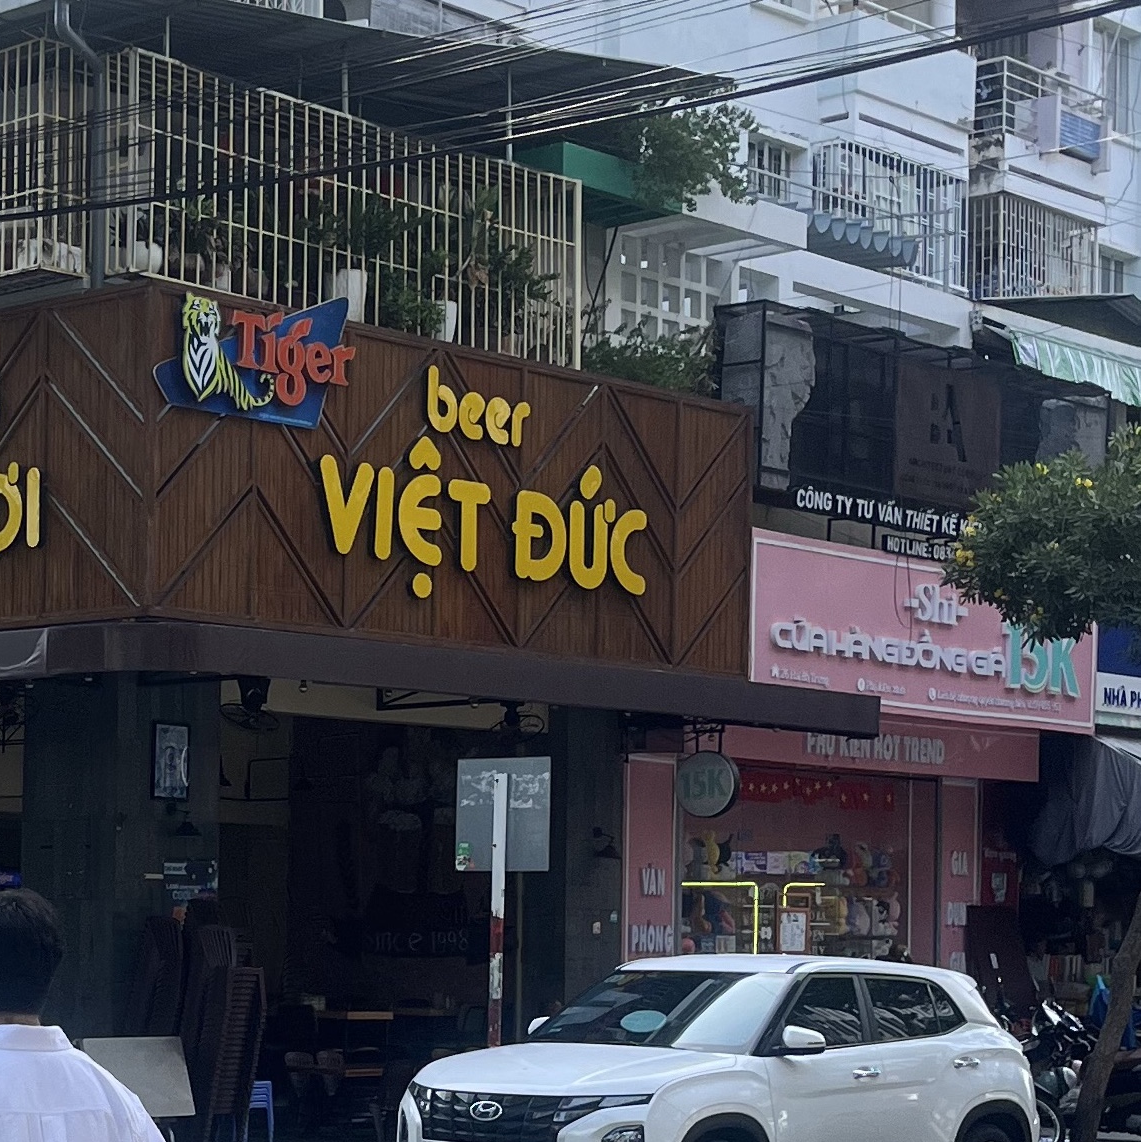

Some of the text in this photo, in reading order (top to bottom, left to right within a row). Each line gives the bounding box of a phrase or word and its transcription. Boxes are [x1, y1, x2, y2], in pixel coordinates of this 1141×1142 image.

[231, 309, 357, 406] Tiger
[427, 365, 531, 447] beer
[320, 435, 648, 599] VIỆT ĐỨC
[796, 485, 833, 511] CÔNG
[836, 494, 854, 515] TY
[856, 498, 875, 519] TƯ
[878, 500, 903, 526] VẤN
[905, 508, 940, 533] THIẾT
[887, 535, 933, 558] HOTLINE:
[827, 624, 900, 664] HÀNG
[1001, 618, 1081, 698] 15K
[874, 734, 900, 762] HOT
[904, 736, 945, 765] TREND
[681, 768, 728, 799] 15K
